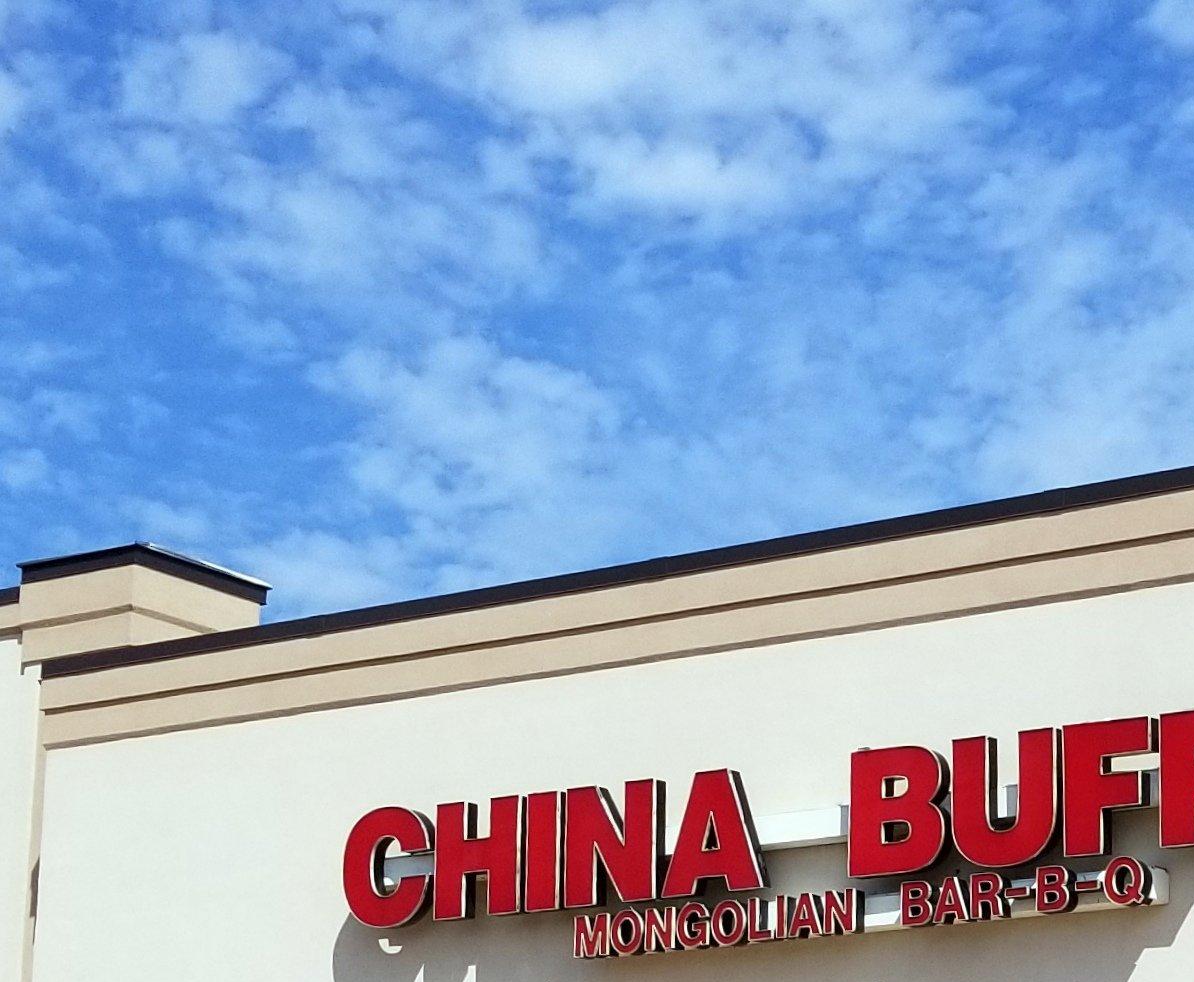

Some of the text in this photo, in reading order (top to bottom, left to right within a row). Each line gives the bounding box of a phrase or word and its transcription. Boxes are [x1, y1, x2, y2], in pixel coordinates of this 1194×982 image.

[342, 768, 769, 928] CHINA
[572, 855, 1150, 958] MONGOLIAN BAR-B-Q
